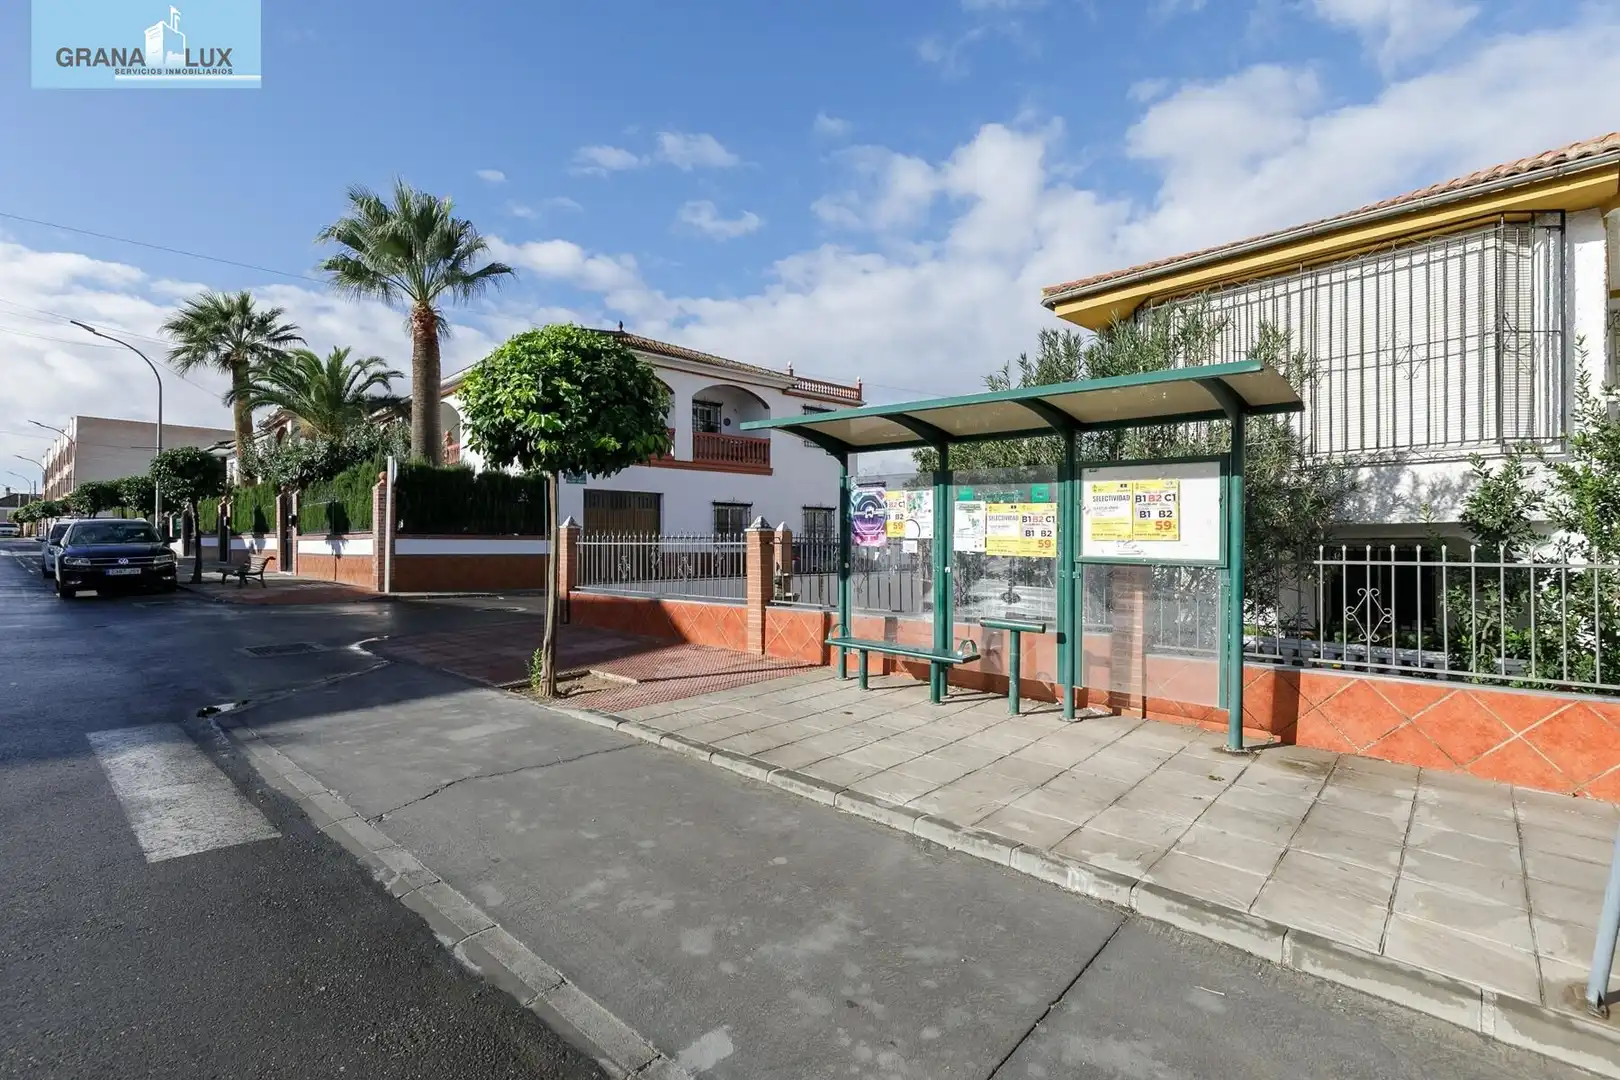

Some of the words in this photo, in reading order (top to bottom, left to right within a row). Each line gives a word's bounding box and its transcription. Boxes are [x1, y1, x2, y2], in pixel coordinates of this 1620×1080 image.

[1092, 494, 1131, 502] SELECTIVIDAD
[1135, 495, 1146, 503] B1
[1148, 494, 1162, 502] B2
[1164, 493, 1176, 502] C1
[1139, 510, 1151, 518] B1
[1158, 510, 1173, 518] B2
[1155, 520, 1172, 531] 59
[1037, 540, 1052, 548] 59
